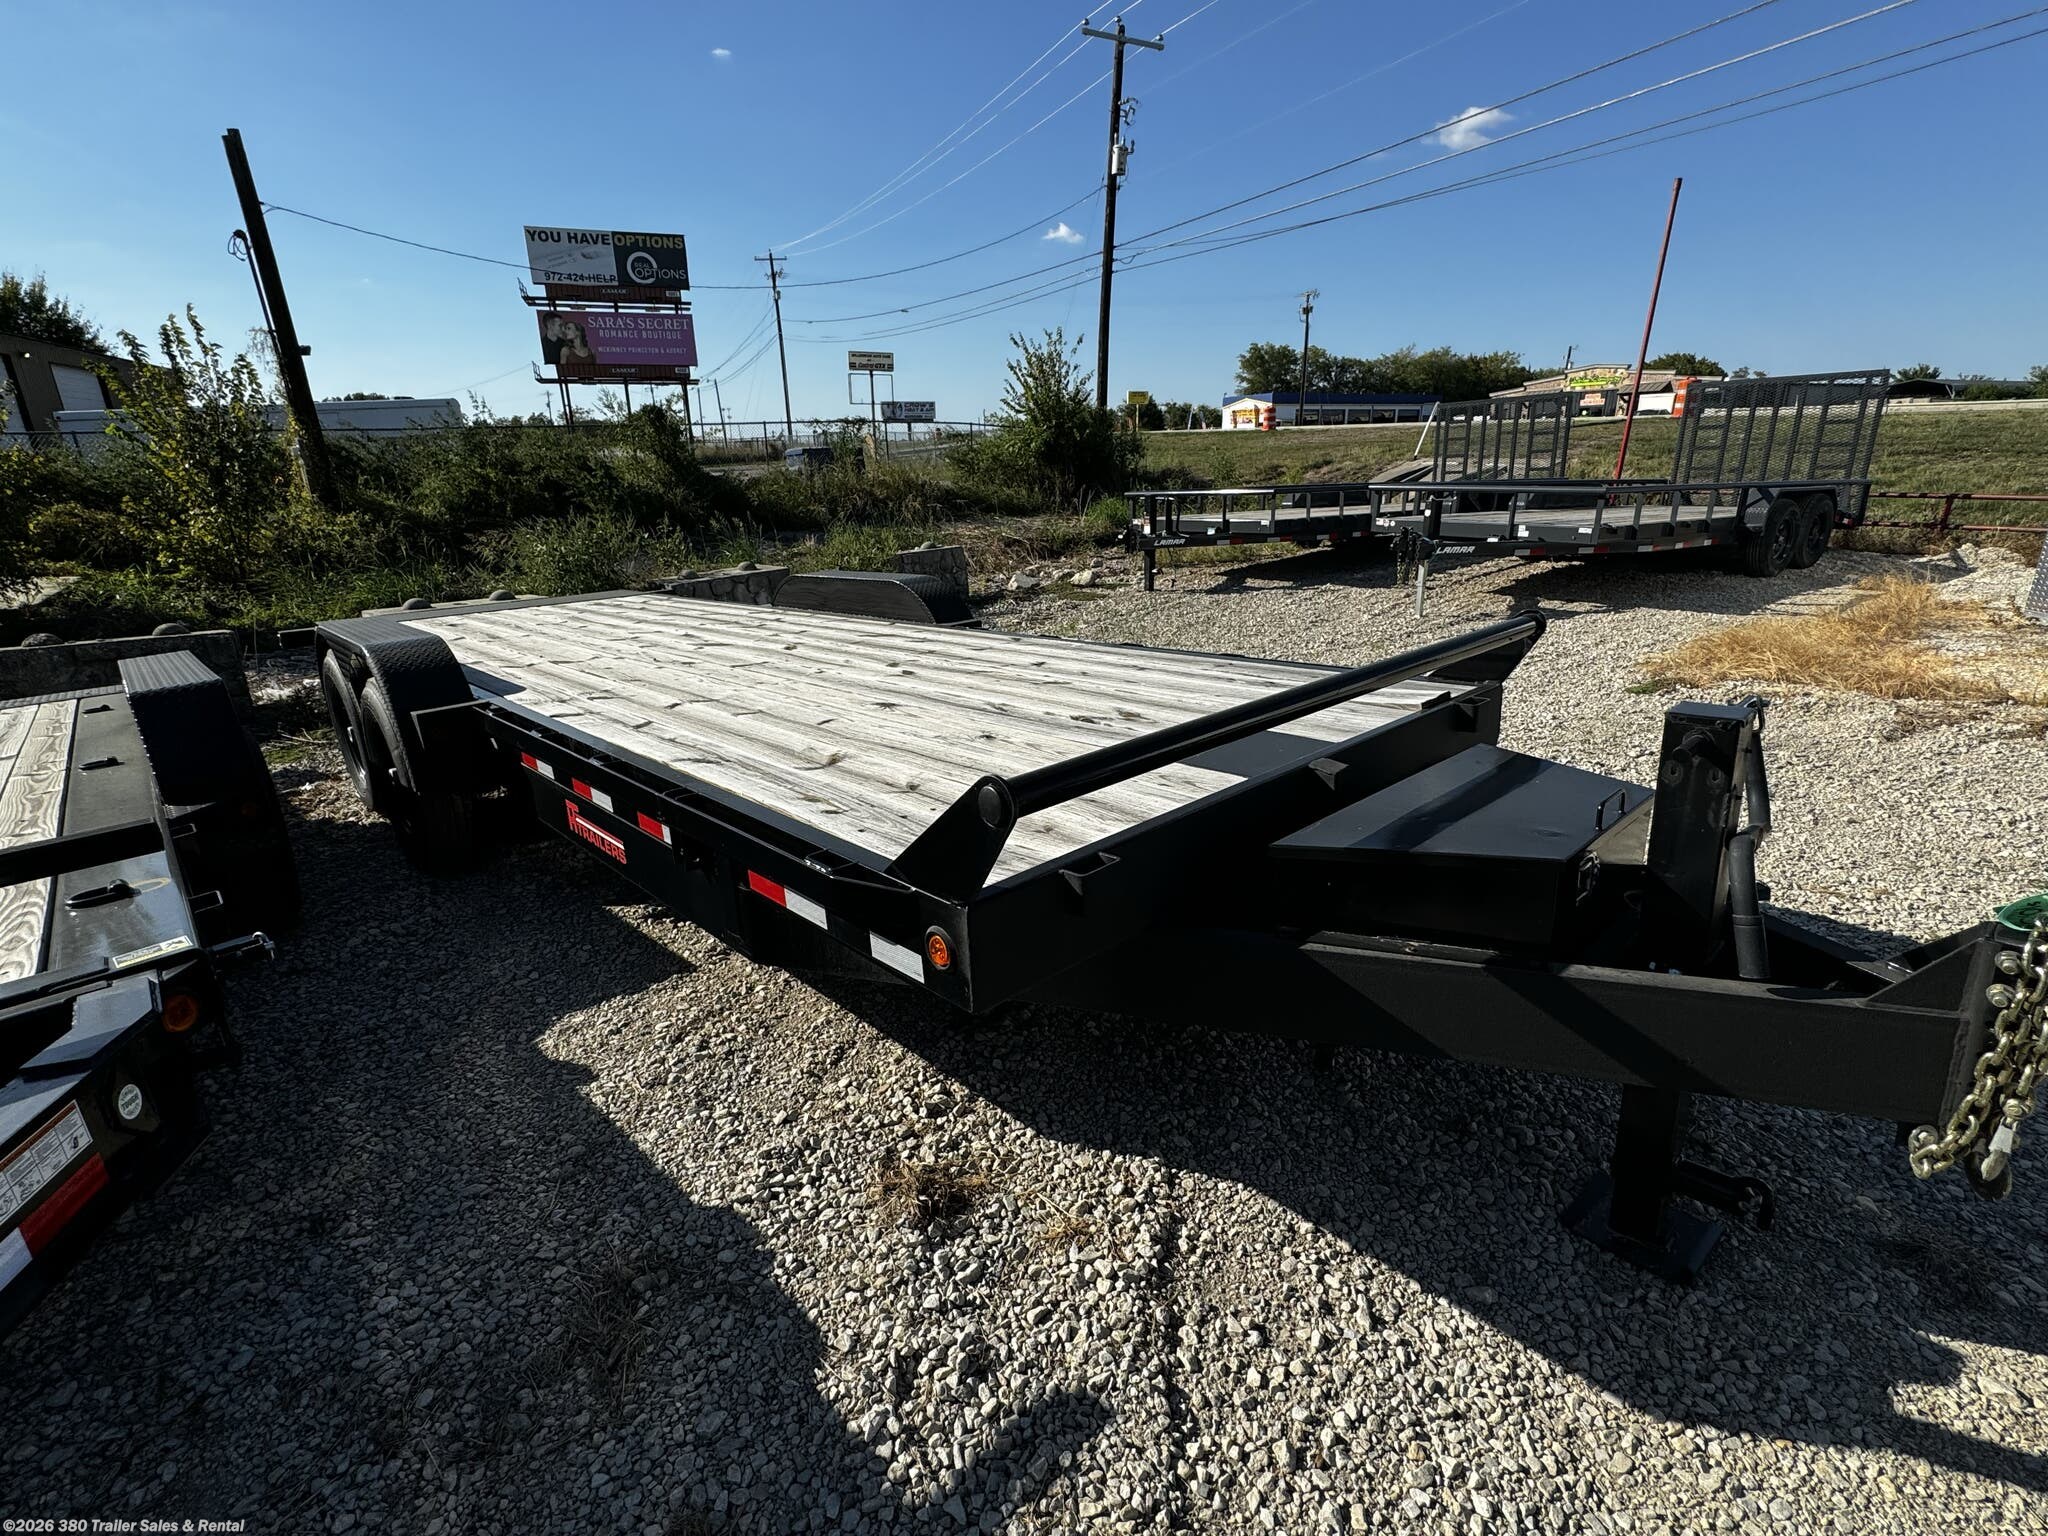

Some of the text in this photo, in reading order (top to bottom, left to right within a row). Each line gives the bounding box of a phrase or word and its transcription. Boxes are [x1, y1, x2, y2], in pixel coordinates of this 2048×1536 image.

[526, 229, 684, 249] YOU HAVE OPTIONS
[544, 271, 617, 284] 972-424-HELP
[634, 267, 687, 280] OPTIONS
[588, 316, 689, 331] SARA'S SECRET
[599, 329, 682, 340] ROMANCE BOUTIQUE
[1154, 538, 1186, 546] LAMAR
[1436, 545, 1476, 555] LAMAR
[576, 822, 627, 865] TRAILERS
